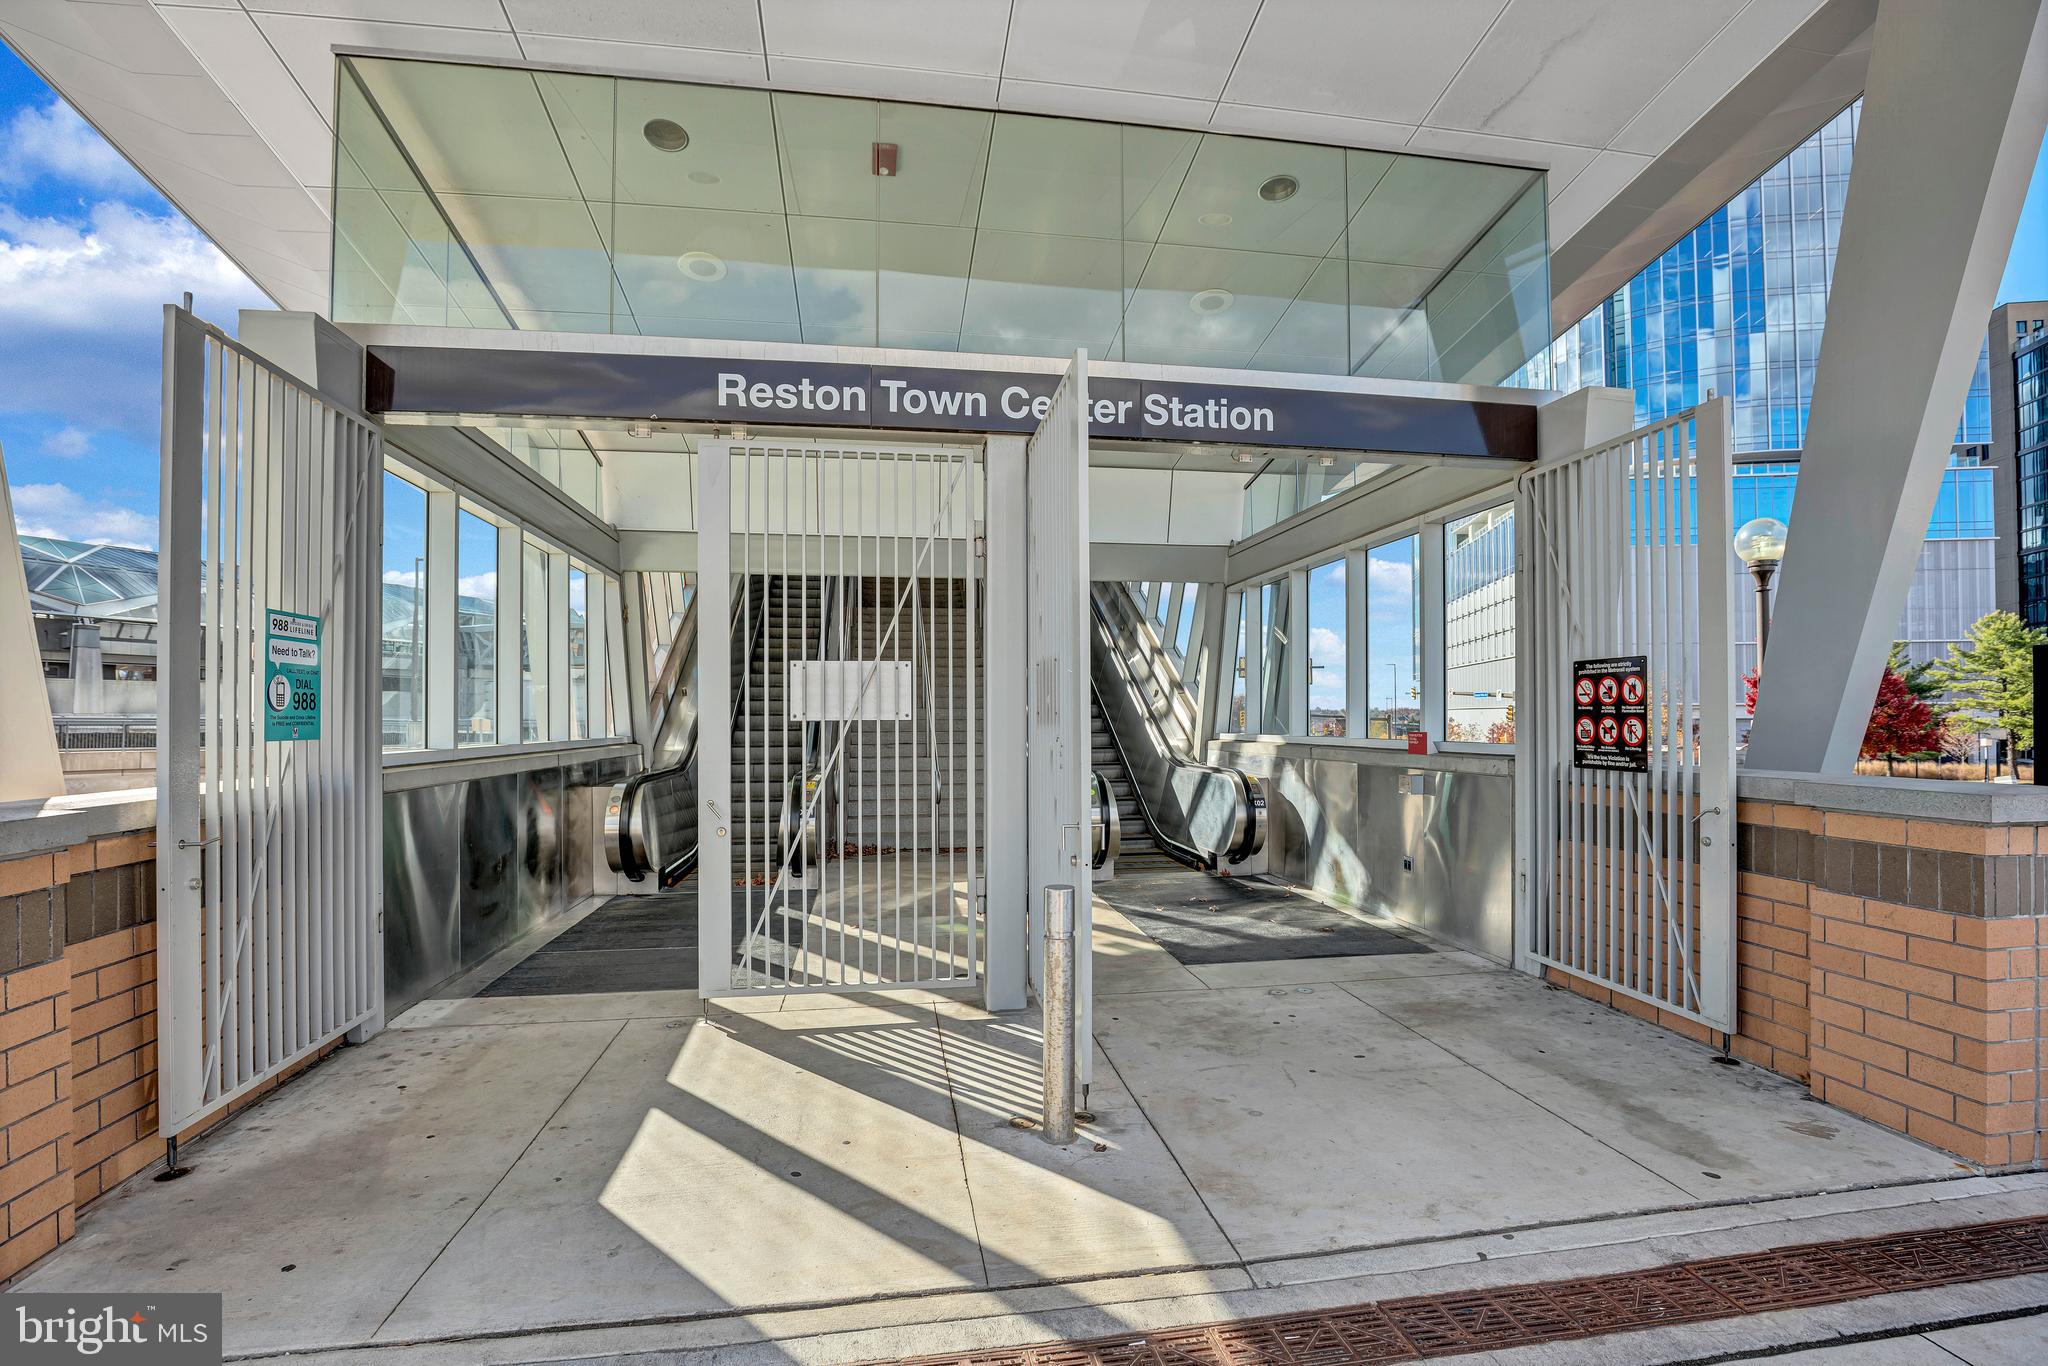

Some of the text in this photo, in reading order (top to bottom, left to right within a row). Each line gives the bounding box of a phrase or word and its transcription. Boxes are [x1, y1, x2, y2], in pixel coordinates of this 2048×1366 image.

[718, 373, 866, 411] Reston
[880, 380, 987, 416] Town
[1144, 393, 1274, 431] Station
[272, 618, 289, 631] 988
[290, 626, 314, 636] LIFELINE
[271, 645, 316, 659] Need to Talk?
[296, 678, 314, 690] DIAL
[293, 692, 316, 711] 988
